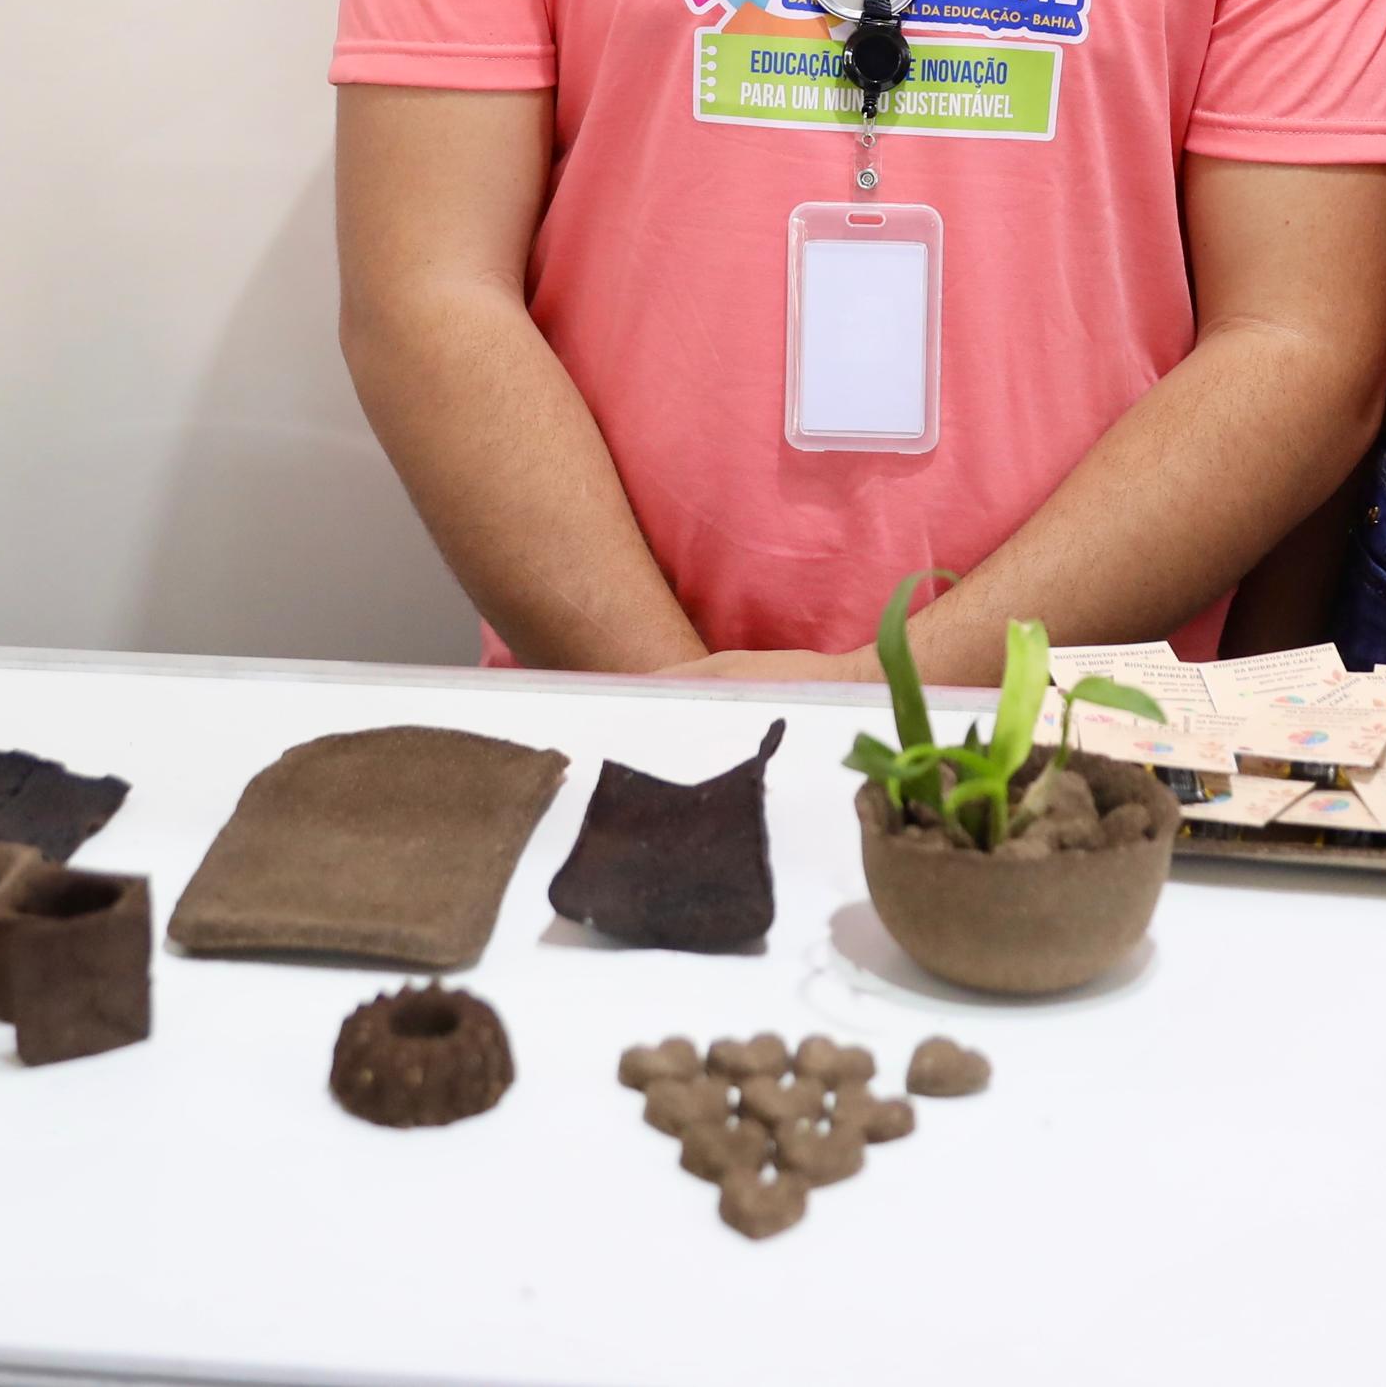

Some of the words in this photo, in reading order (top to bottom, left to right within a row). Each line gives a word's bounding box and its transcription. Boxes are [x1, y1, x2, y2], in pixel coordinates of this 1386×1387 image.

[921, 4, 940, 17] DA
[944, 5, 1020, 25] EDUCAÇÃO
[1033, 15, 1076, 29] BAHIA
[921, 56, 1007, 89] INOVAÇÃO
[740, 83, 787, 108] PARA
[792, 86, 824, 109] UM
[828, 87, 888, 113] MUNO
[894, 87, 1014, 118] SUSTENTÁVEL
